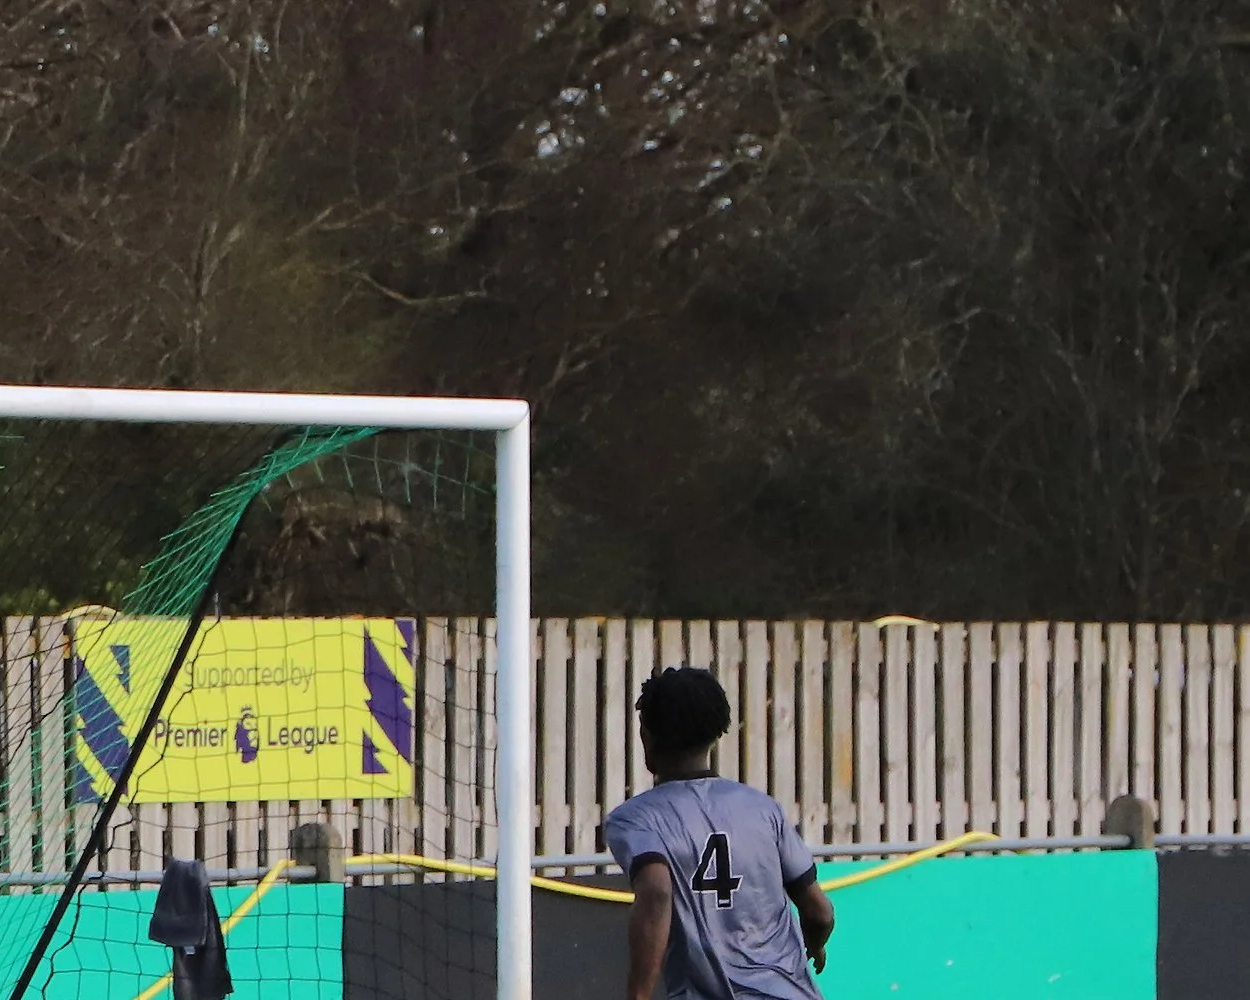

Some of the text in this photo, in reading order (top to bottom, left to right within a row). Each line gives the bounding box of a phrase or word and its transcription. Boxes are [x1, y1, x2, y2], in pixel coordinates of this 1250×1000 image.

[184, 658, 313, 693] Supported by
[154, 716, 339, 754] Premier League
[690, 830, 743, 910] 4
